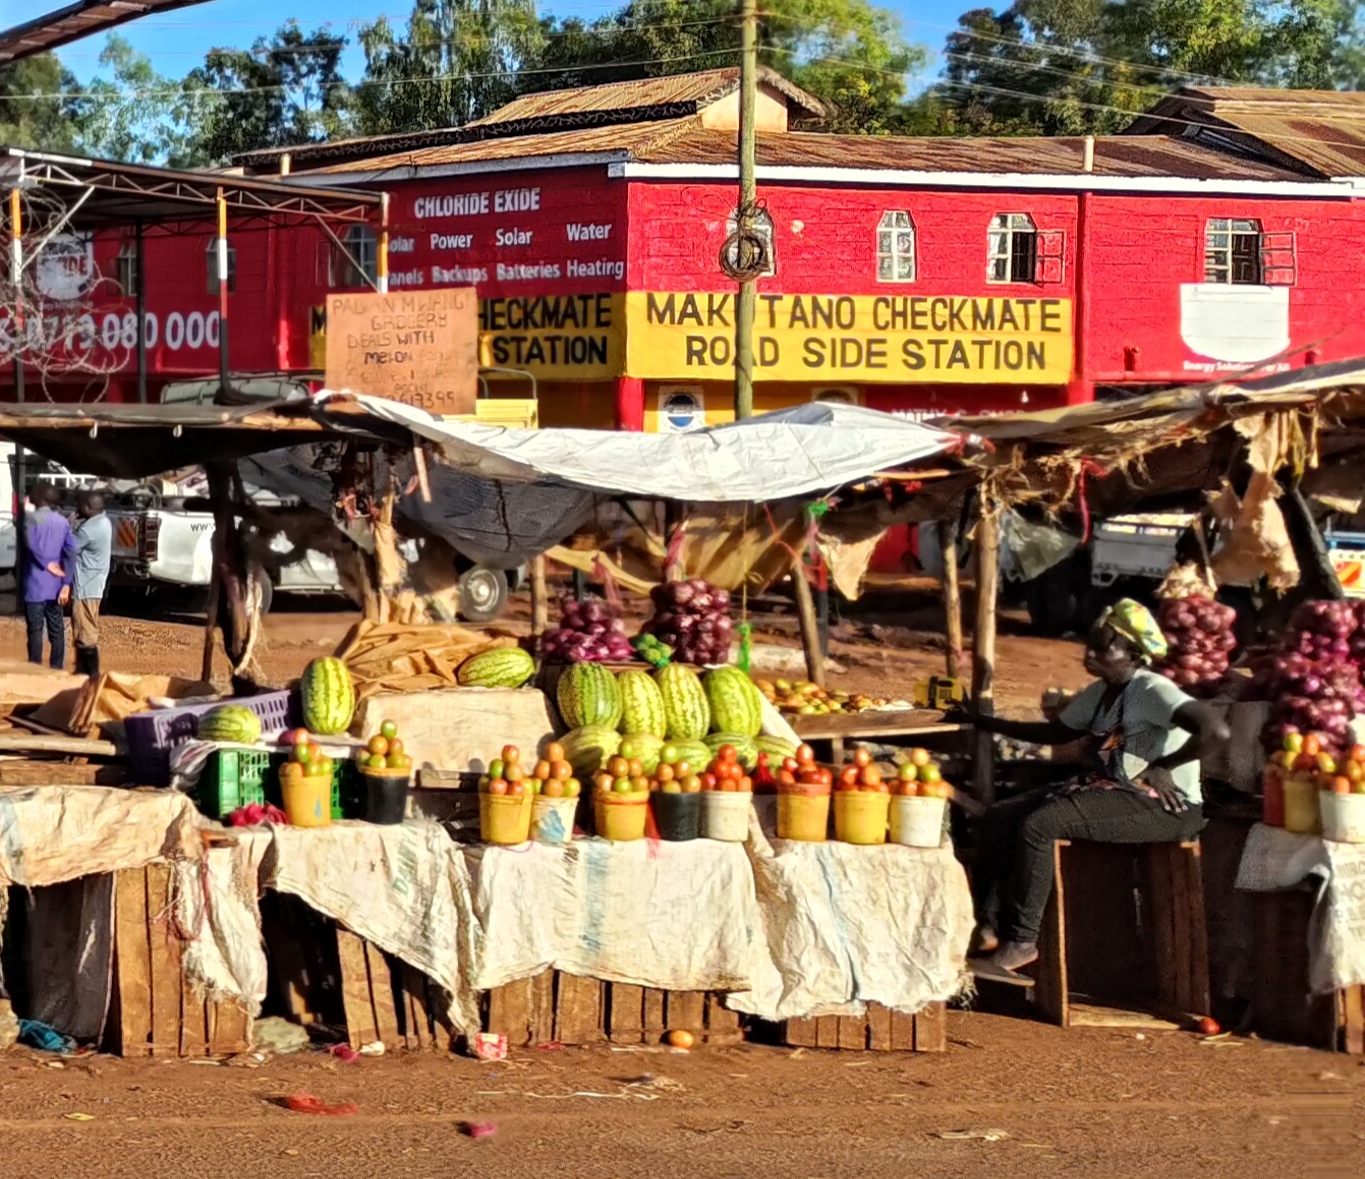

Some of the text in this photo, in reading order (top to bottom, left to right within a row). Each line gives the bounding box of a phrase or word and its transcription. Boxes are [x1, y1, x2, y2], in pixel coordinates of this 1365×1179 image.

[414, 187, 541, 219] CHLORIDE EXIDE
[388, 223, 612, 253] olar Power Solar Water
[388, 257, 624, 286] anels Backups Batteries Heating
[478, 293, 612, 331] HECKMATE
[873, 297, 1062, 332] CHECKMATE
[102, 311, 158, 350] 080
[166, 310, 220, 350] 000
[396, 330, 434, 346] WITH
[493, 335, 608, 365] STATION
[802, 336, 888, 370] SIDE
[902, 339, 1047, 371] STATION
